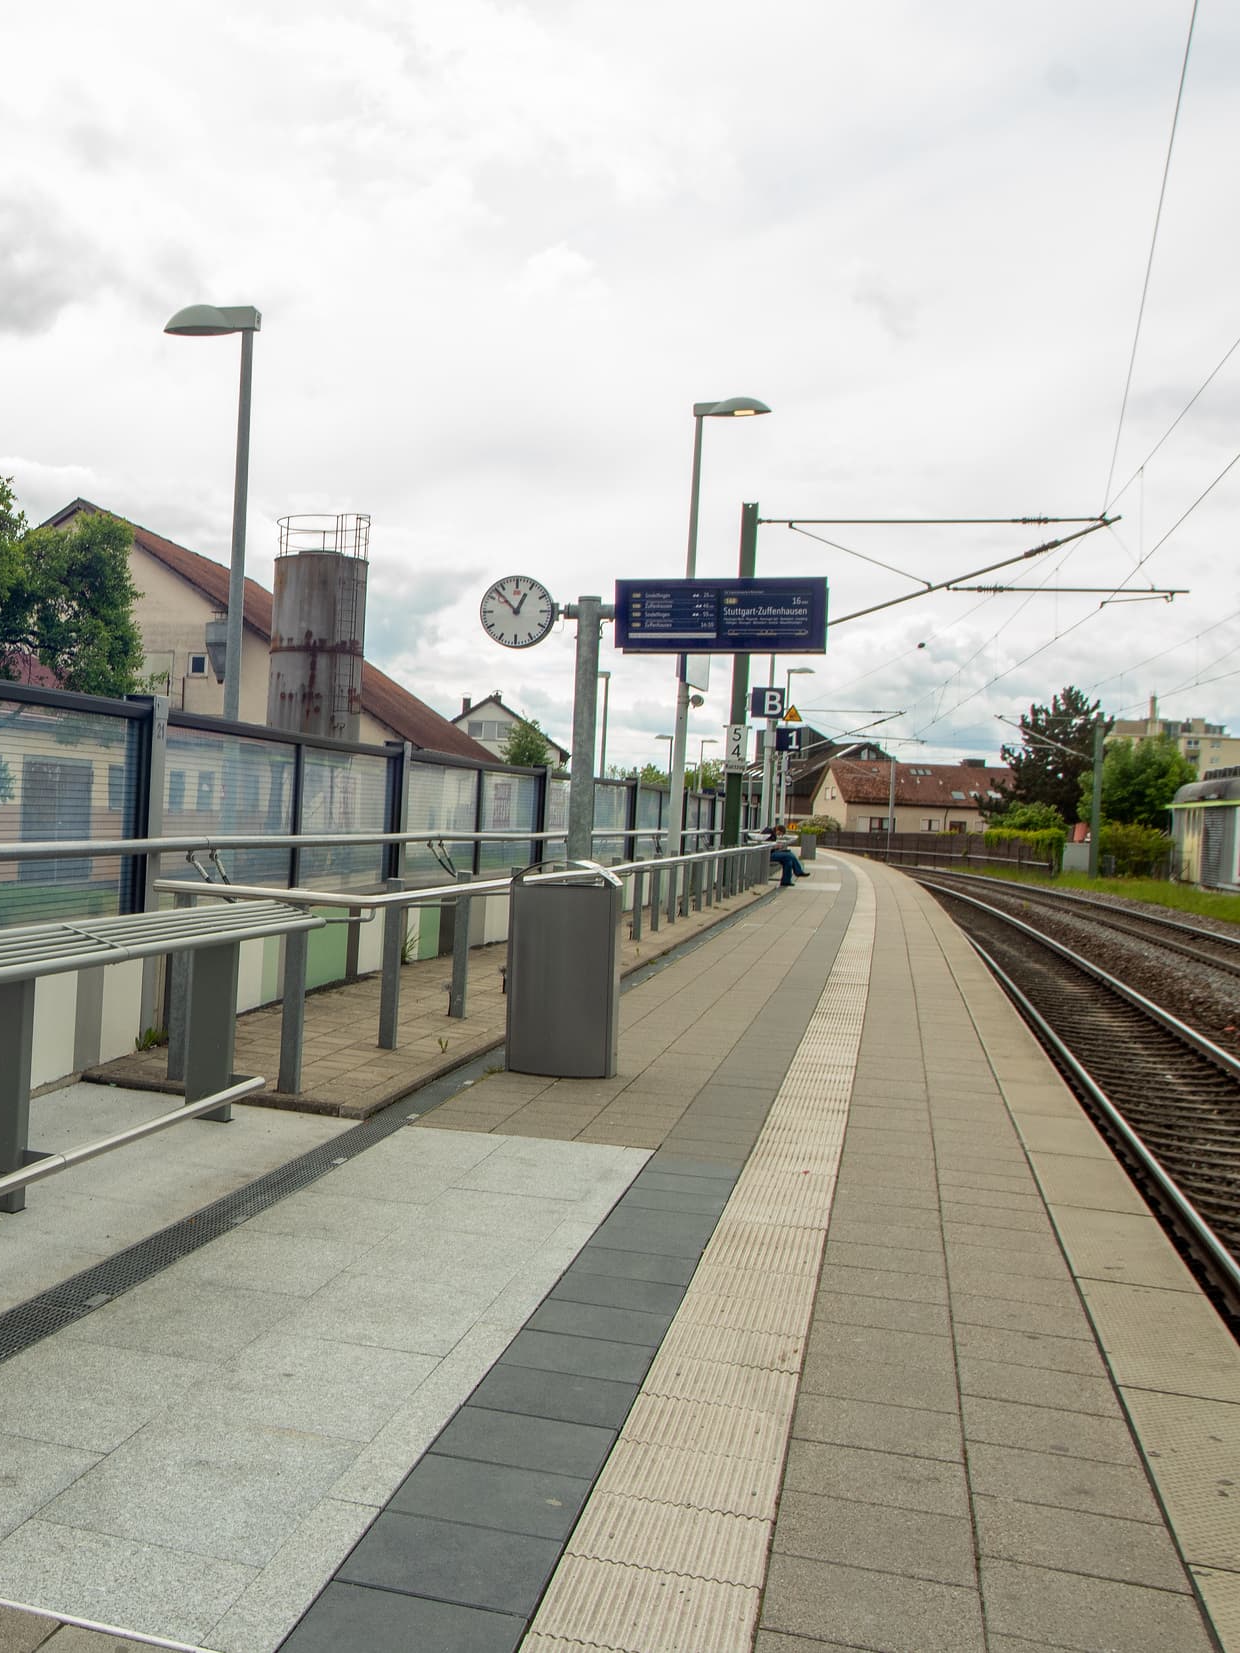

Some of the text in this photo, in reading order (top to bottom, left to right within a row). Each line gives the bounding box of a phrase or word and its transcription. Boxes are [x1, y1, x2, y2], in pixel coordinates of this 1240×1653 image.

[723, 606, 808, 617] Stuttgart-Zuffenhausen
[764, 690, 782, 715] B
[732, 728, 741, 741] 5
[788, 731, 800, 749] 1
[731, 744, 741, 757] 4
